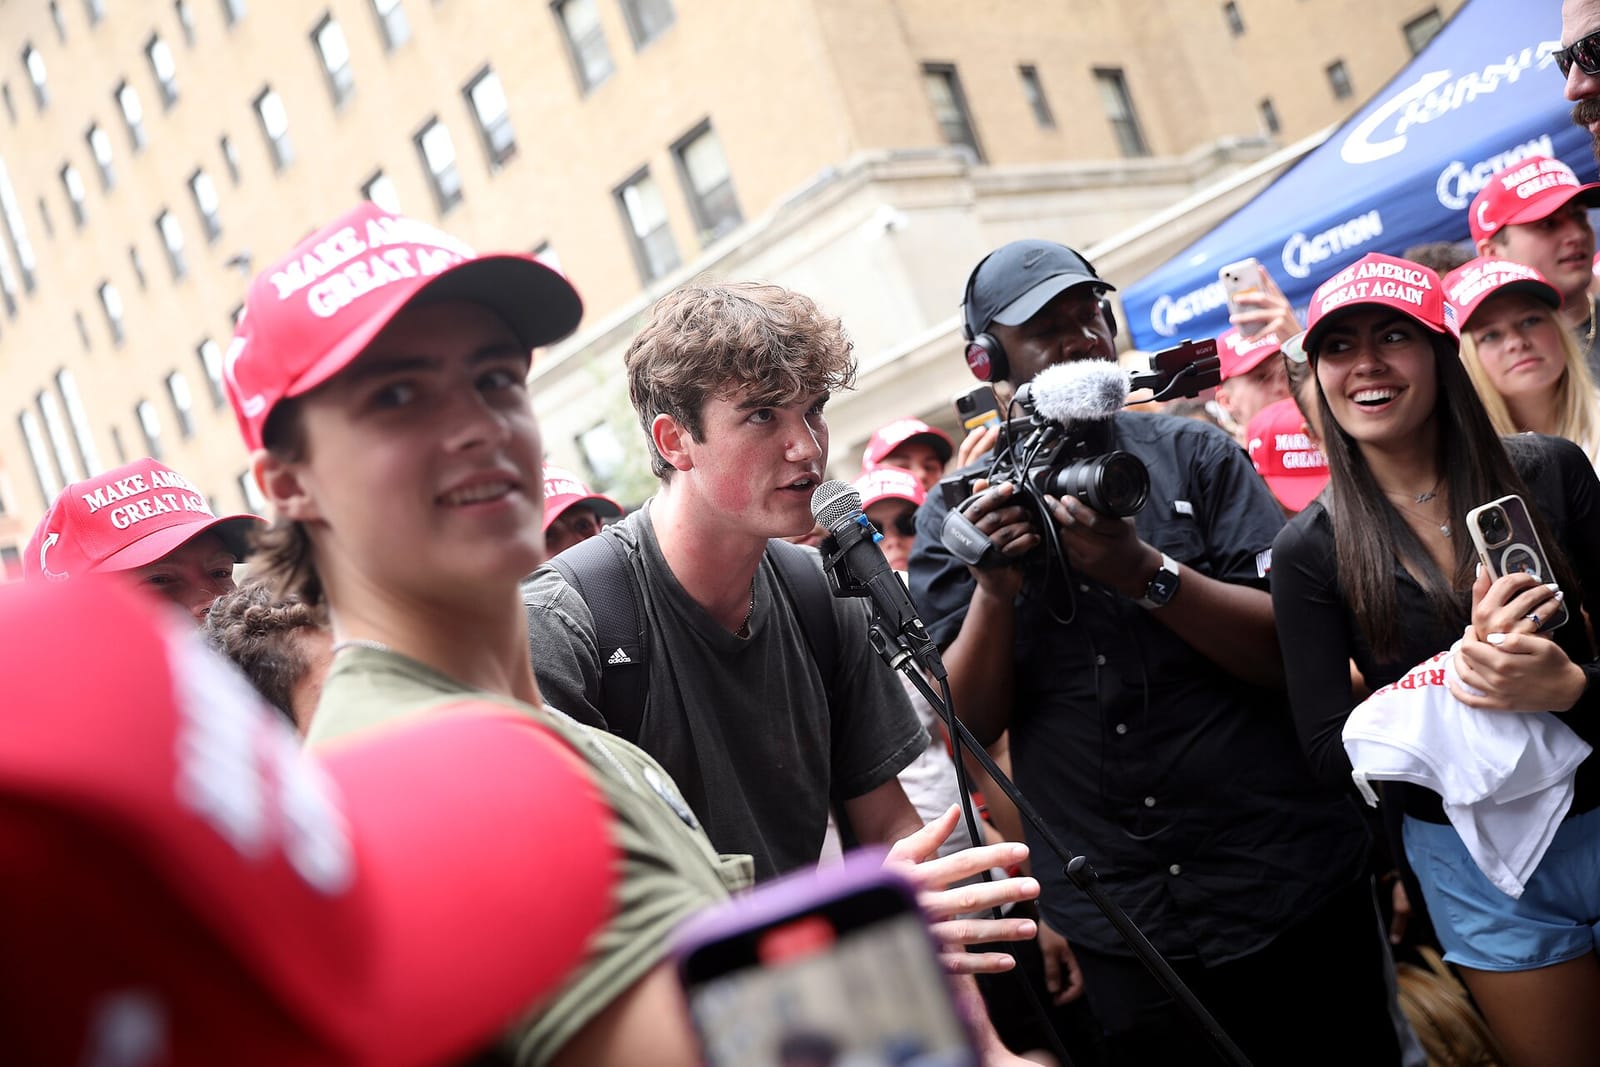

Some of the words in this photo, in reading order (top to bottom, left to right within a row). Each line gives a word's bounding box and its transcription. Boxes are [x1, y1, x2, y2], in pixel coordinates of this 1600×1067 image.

[1300, 210, 1383, 264] ACTION
[268, 226, 368, 300] MAKE
[1356, 263, 1432, 290] AMERICA
[307, 248, 417, 317] GREAT
[1321, 282, 1370, 315] GREAT
[1370, 281, 1424, 306] AGAIN
[82, 474, 150, 513] MAKE
[110, 494, 182, 529] GREAT
[951, 527, 973, 546] SONY
[608, 656, 632, 665] adidas
